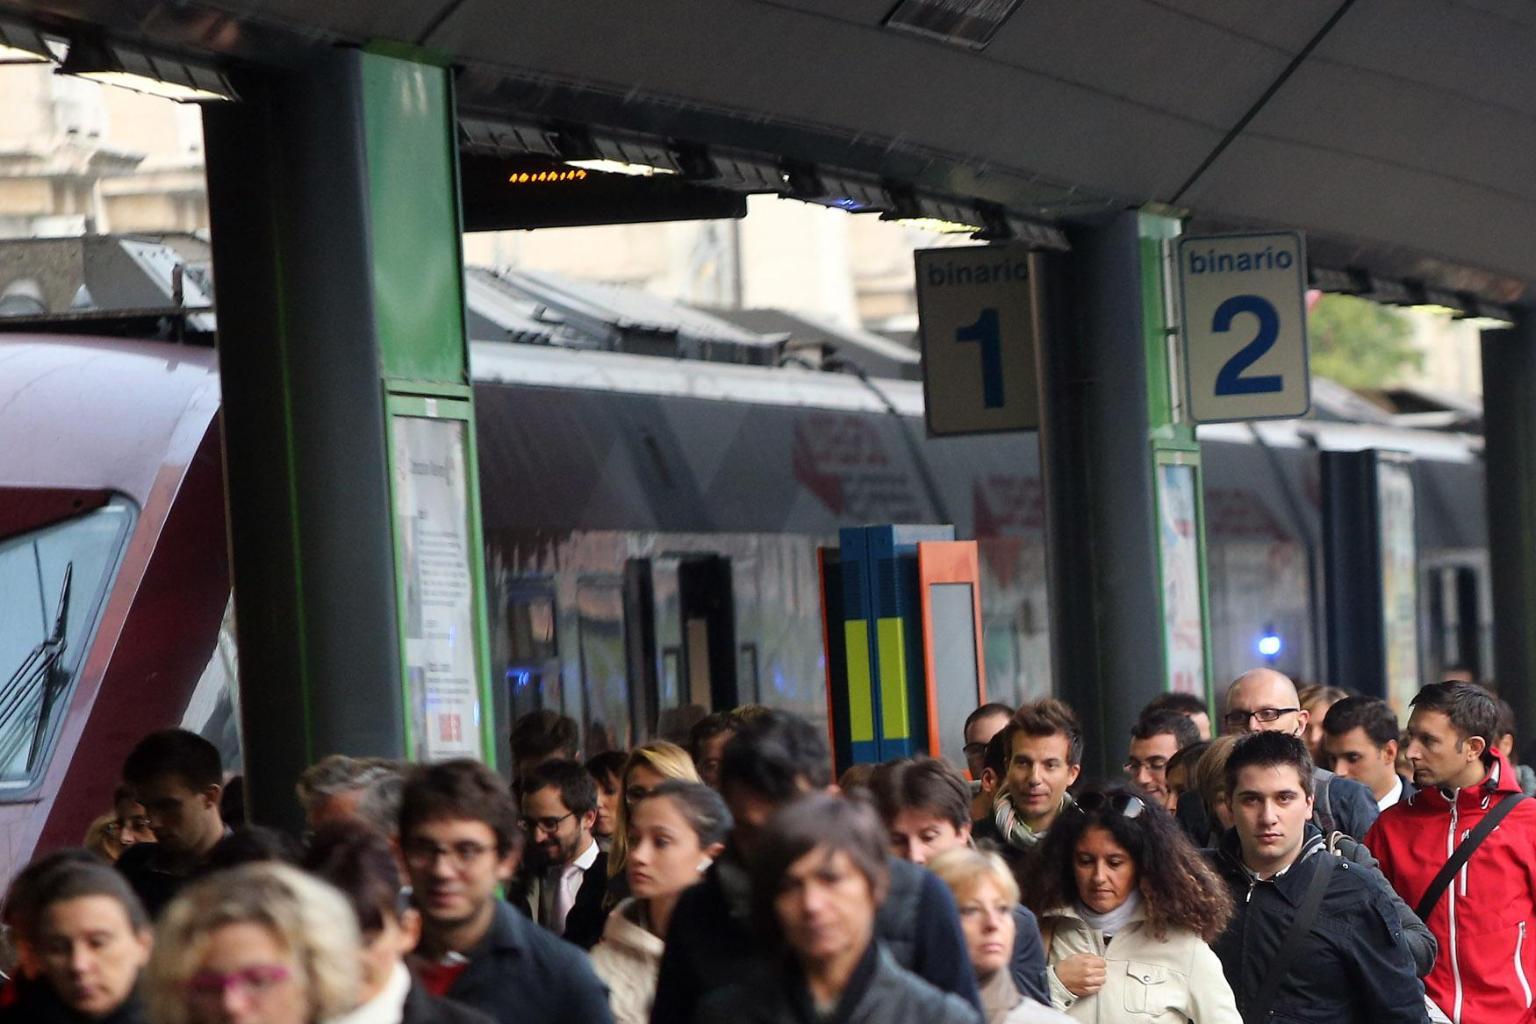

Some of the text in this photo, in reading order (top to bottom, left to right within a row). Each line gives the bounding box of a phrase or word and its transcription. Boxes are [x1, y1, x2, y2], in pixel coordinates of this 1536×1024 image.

[1190, 246, 1293, 274] binario
[955, 307, 1005, 409] 1
[1211, 294, 1284, 396] 2
